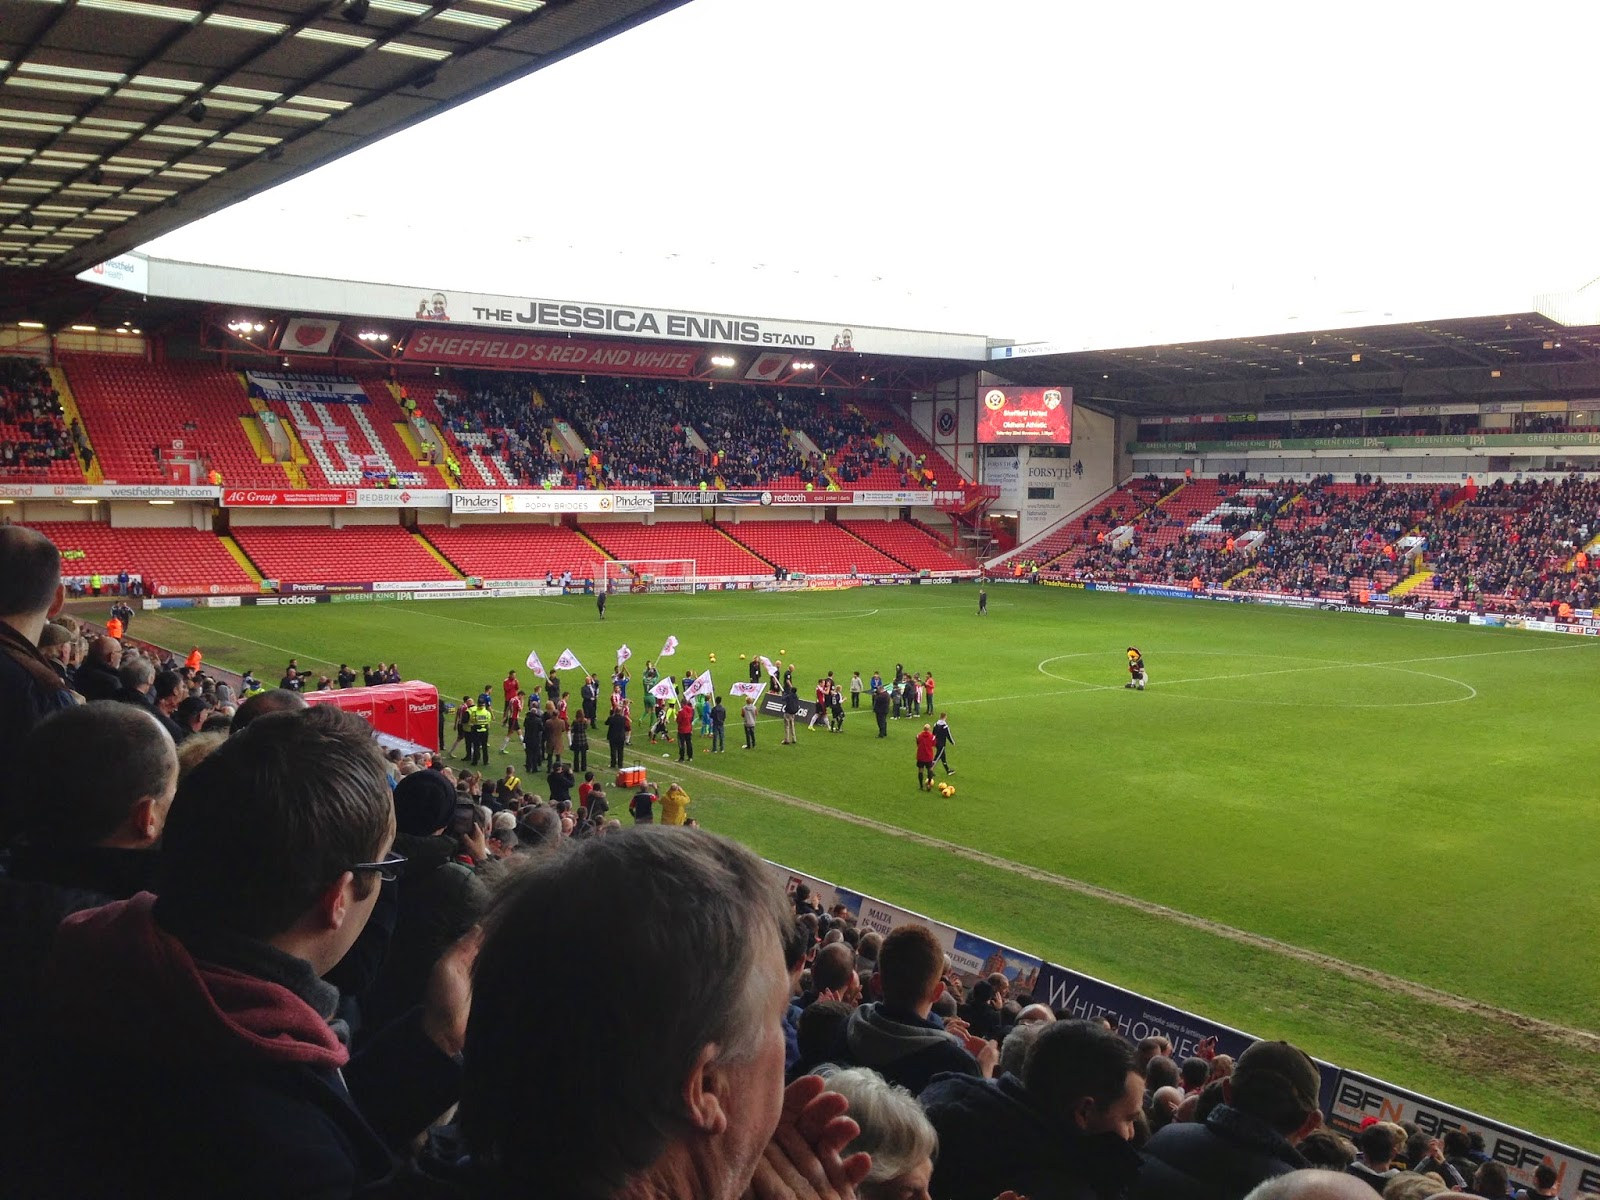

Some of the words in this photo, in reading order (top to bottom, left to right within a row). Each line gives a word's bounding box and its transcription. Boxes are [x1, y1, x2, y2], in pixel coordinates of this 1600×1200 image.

[104, 260, 134, 272] Westfield
[472, 306, 513, 322] THE
[516, 302, 661, 335] JESSICA
[666, 314, 760, 342] ENNIS
[762, 332, 815, 346] STAND
[414, 334, 546, 362] SHEFFIELD'S
[546, 344, 588, 363] RED
[586, 348, 630, 366] AND
[632, 350, 693, 370] WHITE
[1364, 438, 1378, 447] IPA
[1470, 435, 1486, 445] IPA
[1528, 434, 1560, 442] GREENE
[174, 440, 182, 448] G
[1184, 442, 1197, 450] IPA
[1268, 440, 1282, 448] IPA
[1028, 468, 1072, 478] FORSYTH
[0, 486, 33, 496] Stand
[110, 487, 212, 497] westfieldhealth.com
[226, 492, 245, 502] AG
[246, 492, 277, 504] Group
[360, 494, 400, 502] REDBRIK
[455, 495, 498, 506] Pinders
[616, 495, 652, 506] Pinders
[774, 492, 806, 502] redtooth
[293, 583, 325, 591] Premier
[1044, 580, 1085, 589] TradePoint.co.uk
[280, 595, 316, 605] adidas
[397, 592, 413, 600] IPA
[1340, 604, 1353, 613] john
[1354, 606, 1374, 614] holland
[1425, 612, 1457, 623] adidas
[1556, 624, 1568, 632] sky
[408, 703, 436, 712] Pinders
[868, 908, 892, 924] MALTA
[862, 918, 870, 926] IS
[870, 920, 892, 936] MORE
[953, 954, 980, 970] EXPLORE
[1142, 1011, 1166, 1027] bespoke
[1166, 1020, 1180, 1032] sales
[1342, 1083, 1404, 1123] BFN
[1414, 1110, 1482, 1139] BF
